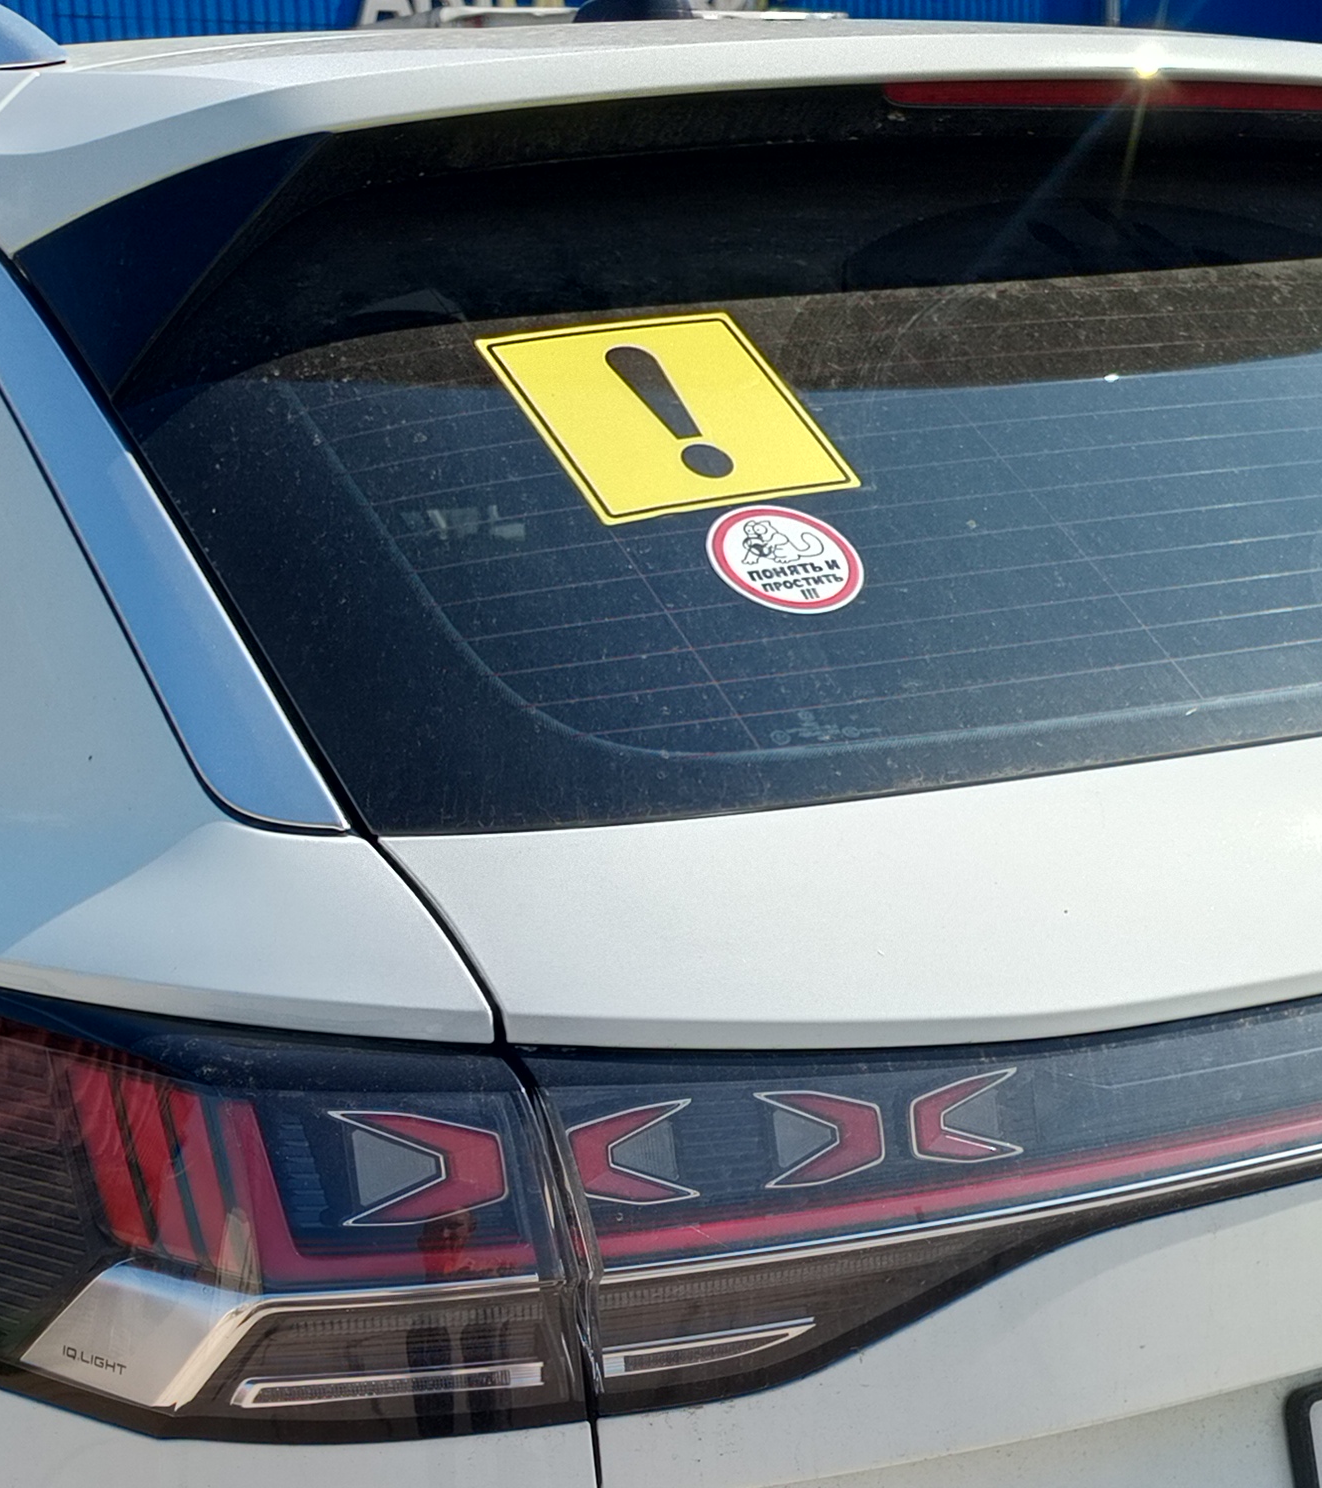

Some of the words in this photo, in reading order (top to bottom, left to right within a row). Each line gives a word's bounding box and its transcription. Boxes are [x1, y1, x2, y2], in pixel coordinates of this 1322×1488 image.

[746, 562, 824, 582] ПОНЯТЬ
[824, 559, 842, 570] И
[761, 573, 844, 593] ПРОСТИТЬ
[62, 1345, 127, 1375] IQ.LIGHT
